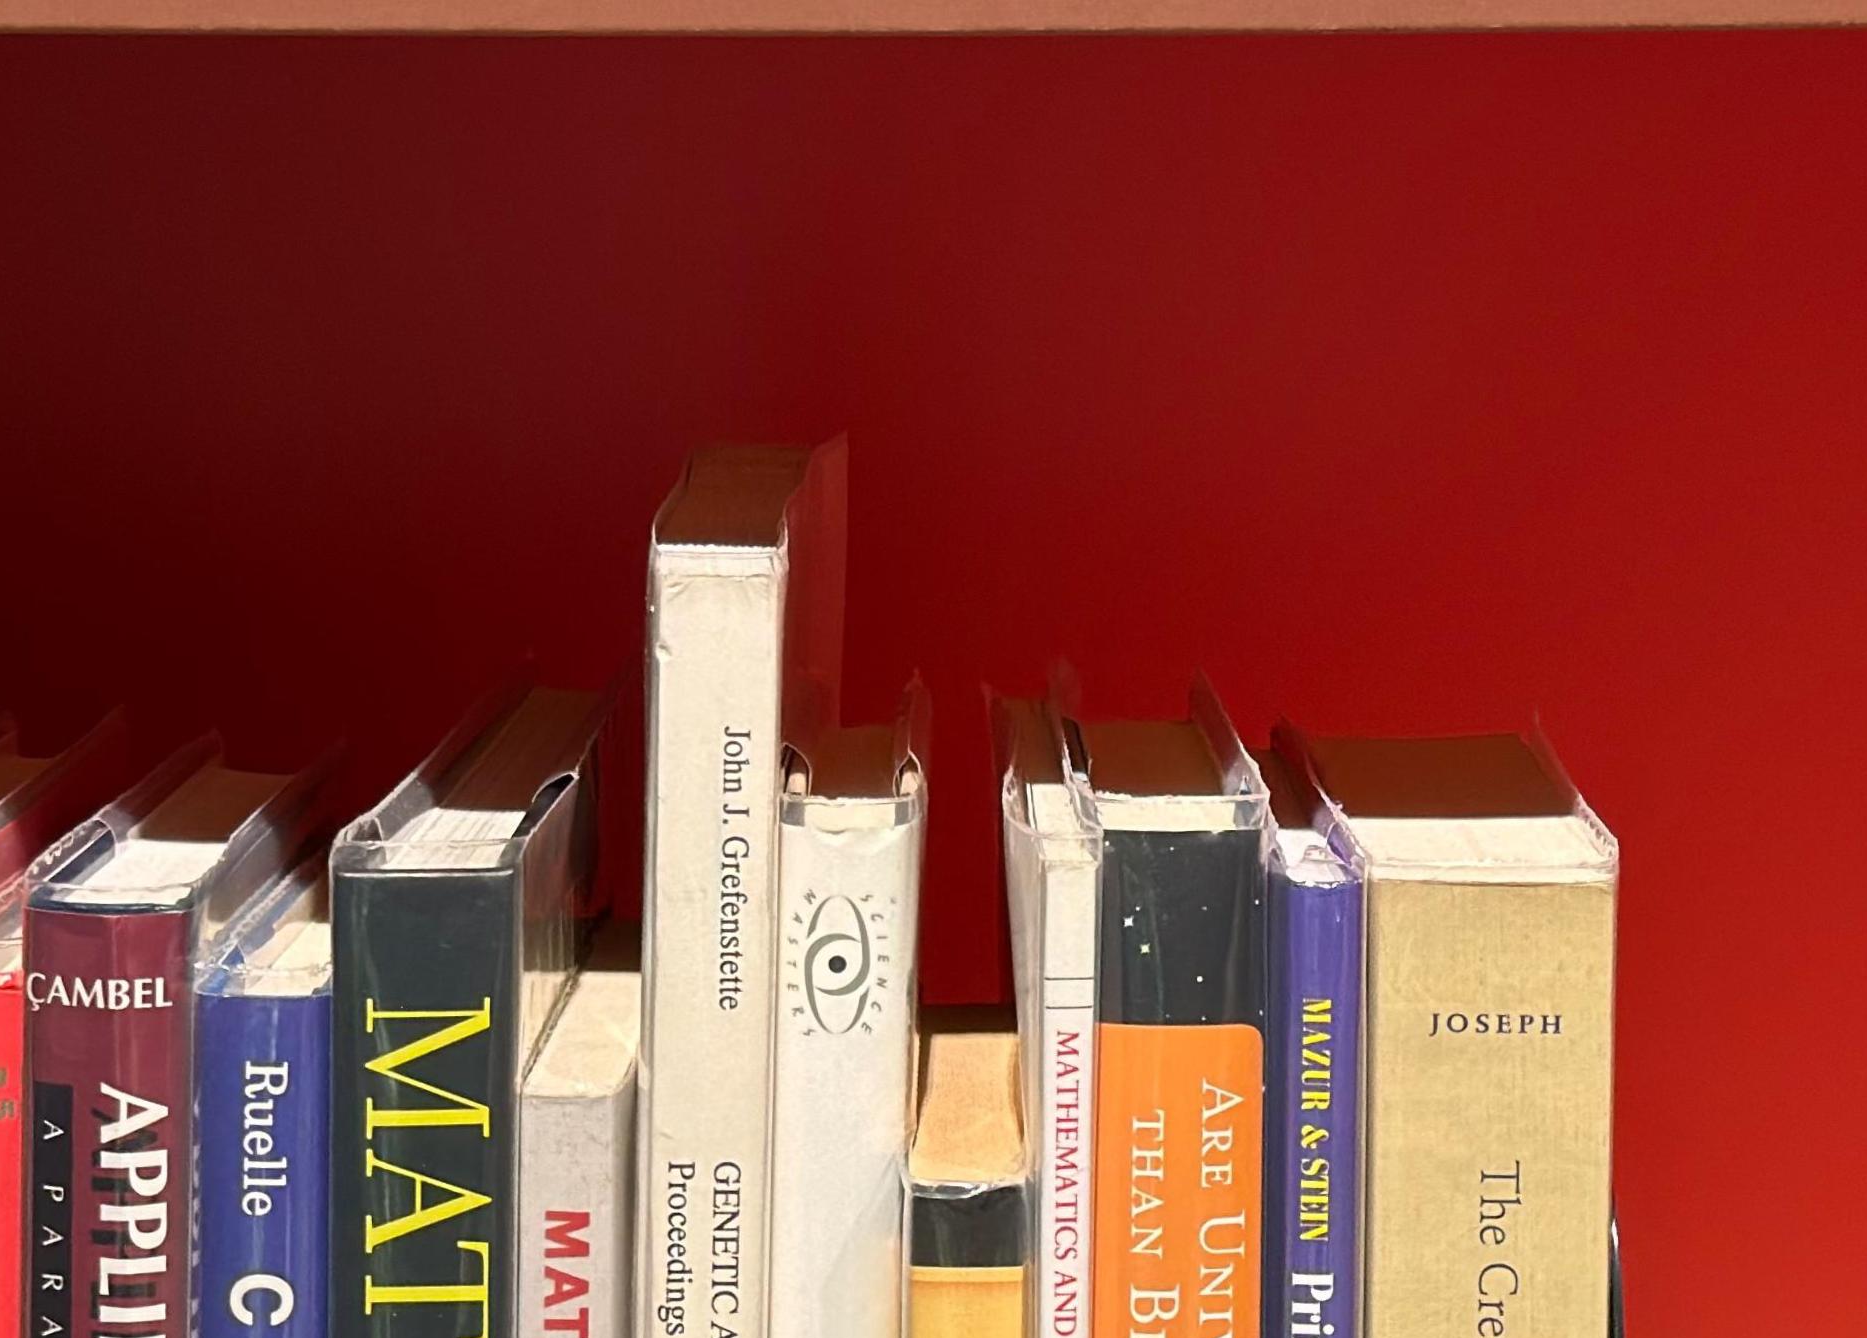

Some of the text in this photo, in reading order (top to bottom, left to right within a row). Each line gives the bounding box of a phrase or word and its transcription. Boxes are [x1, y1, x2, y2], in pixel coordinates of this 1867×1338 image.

[717, 726, 752, 1011] John Grefenstette
[27, 972, 173, 1010] ÇAMBEL
[786, 888, 817, 1037] MASTERS
[860, 893, 890, 1035] SCIENCE
[1430, 1012, 1564, 1036] JOSEPH
[241, 1061, 290, 1216] Ruelle
[1054, 1030, 1080, 1261] MATHEMATICS
[1131, 1109, 1165, 1260] THAN
[1200, 1078, 1244, 1188] ARE
[1299, 997, 1332, 1242] MAZUR STEIN
[658, 1162, 696, 1337] Proceedings
[710, 1161, 743, 1315] GENETIC
[1480, 1161, 1520, 1246] The
[1053, 1270, 1078, 1337] AND
